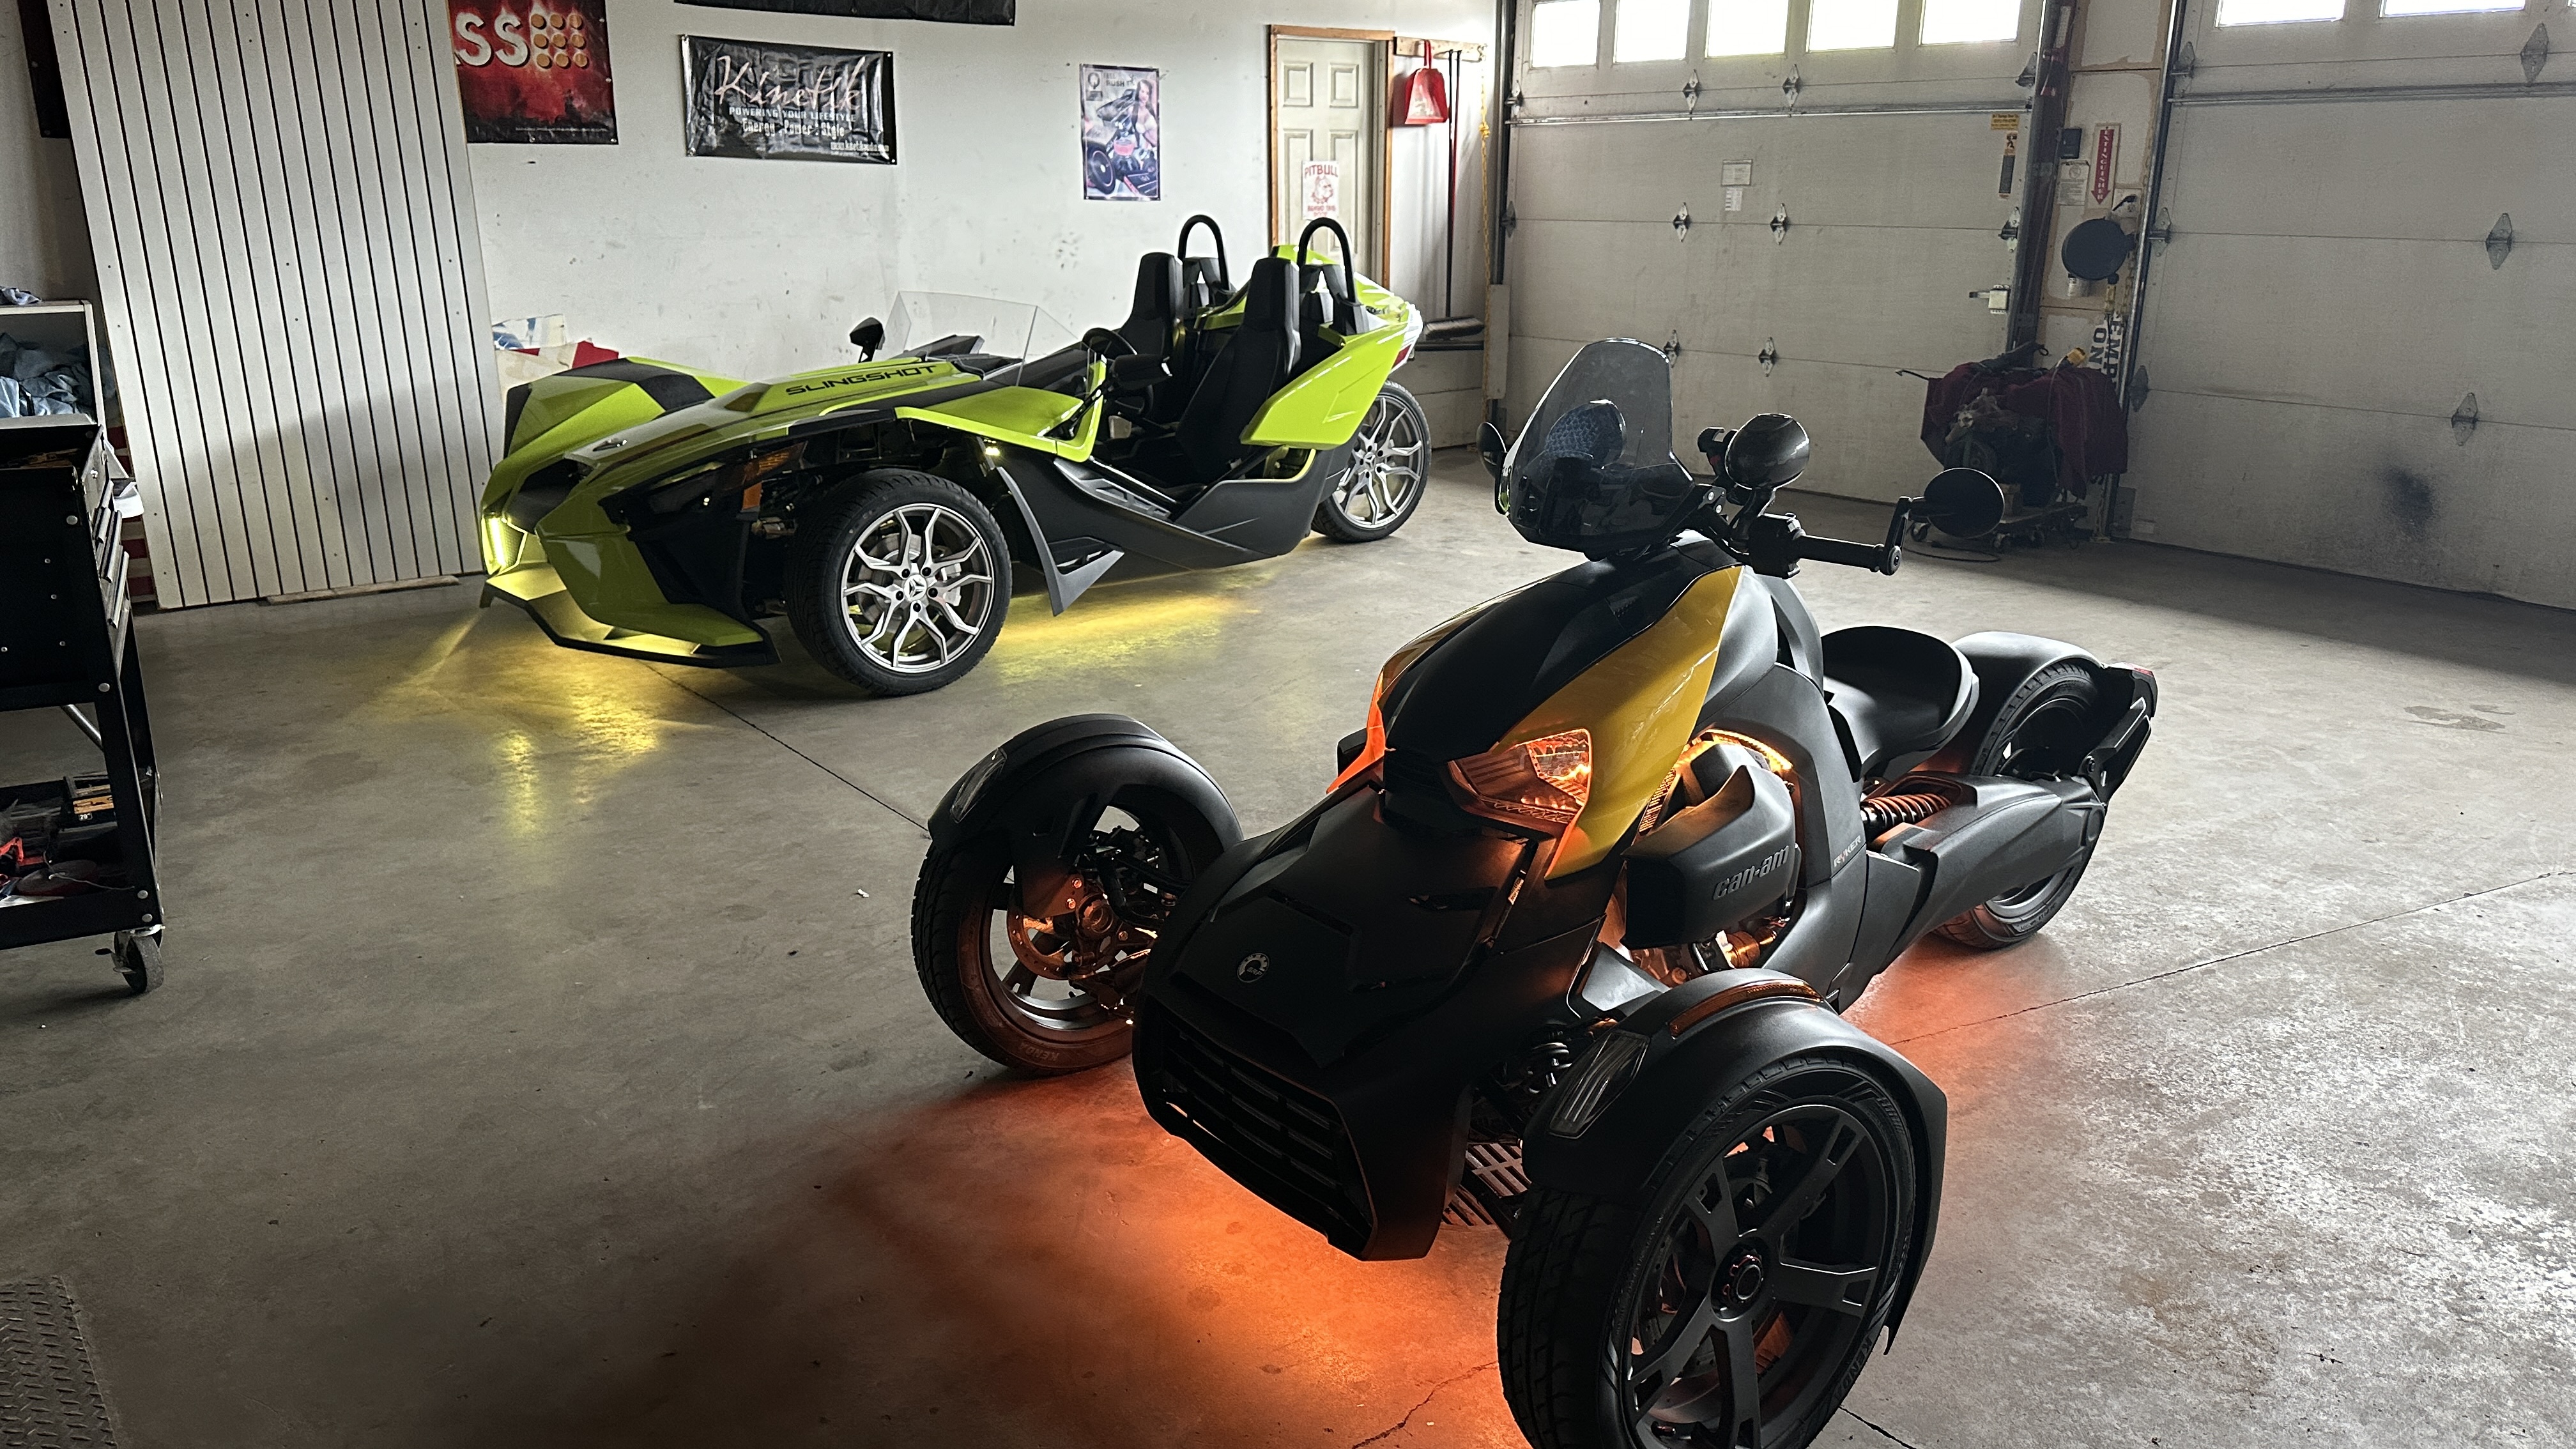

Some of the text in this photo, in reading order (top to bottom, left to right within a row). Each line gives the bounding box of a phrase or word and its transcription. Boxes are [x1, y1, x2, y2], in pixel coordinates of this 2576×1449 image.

[455, 12, 530, 66] SS
[714, 55, 866, 111] Kinetik
[729, 107, 857, 123] POWERING YOUR LIFESTYLE
[742, 118, 776, 137] Energy
[820, 122, 845, 140] Style
[1305, 164, 1338, 179] PITBULL
[2089, 328, 2107, 365] ON
[785, 365, 937, 395] SLINGSHOT
[1833, 835, 1861, 868] RYKER
[1713, 845, 1789, 900] can-am
